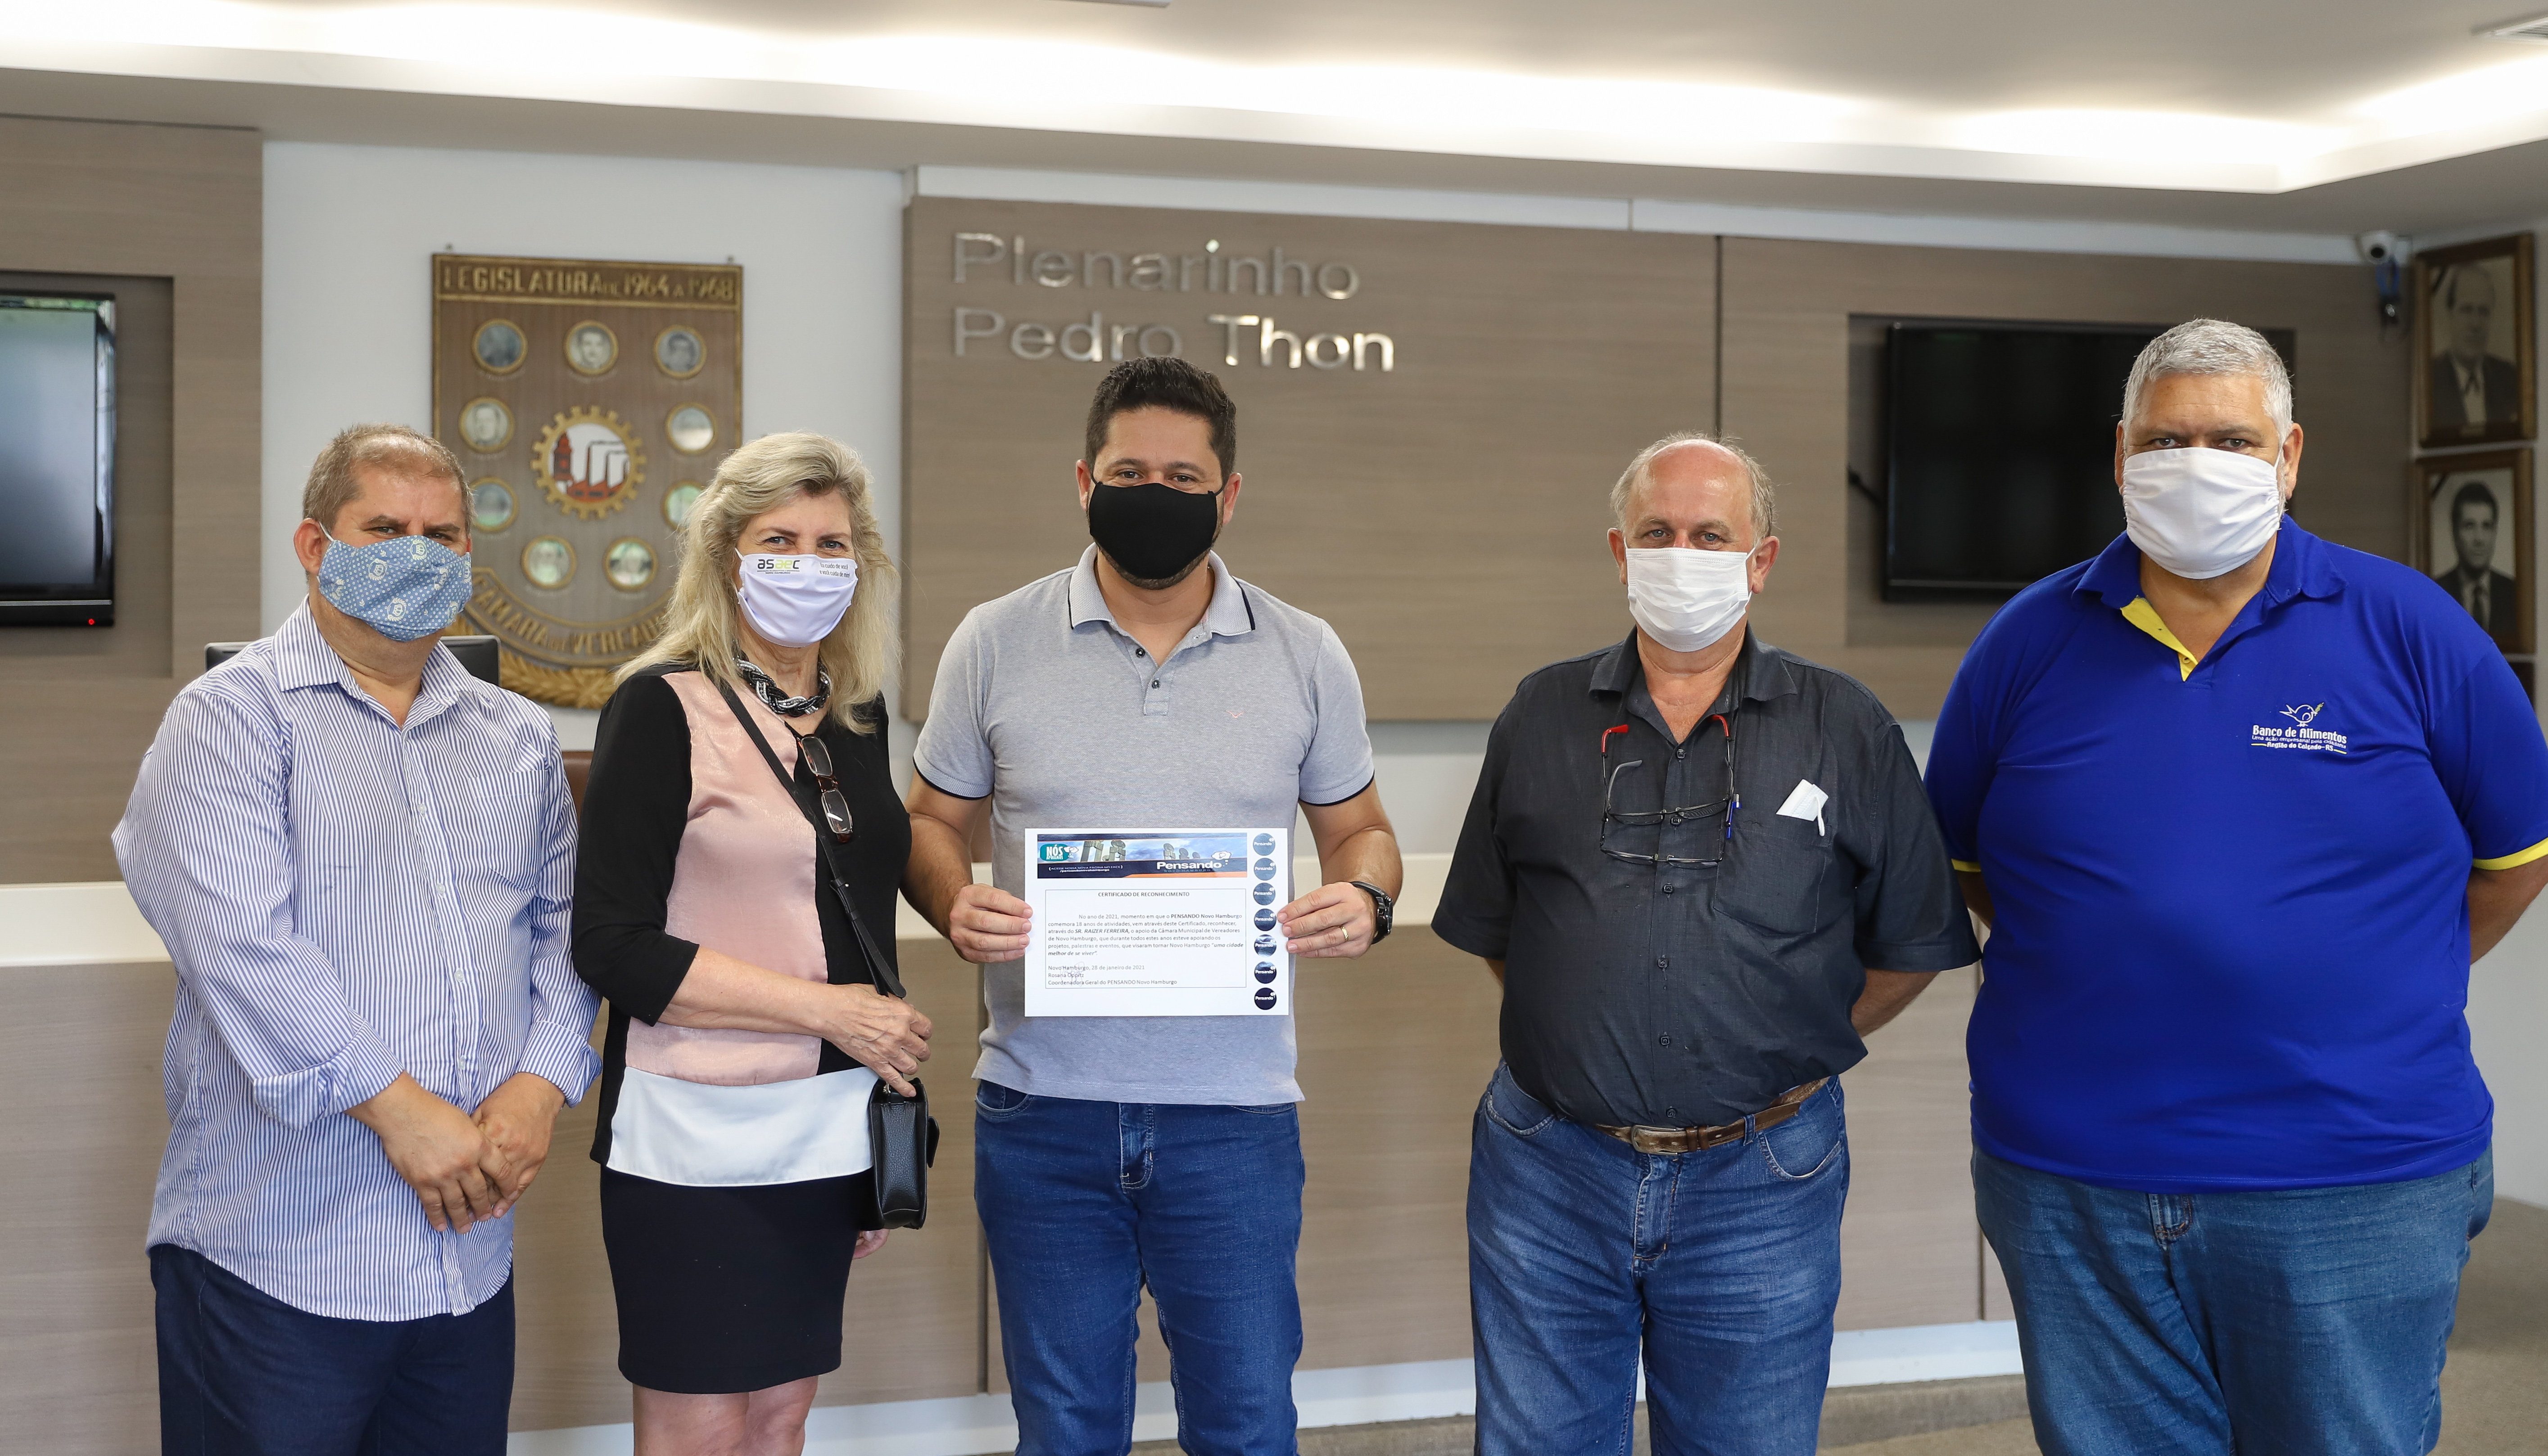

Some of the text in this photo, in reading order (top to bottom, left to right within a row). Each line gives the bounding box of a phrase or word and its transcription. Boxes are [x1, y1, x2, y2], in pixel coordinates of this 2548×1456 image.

[953, 232, 1359, 300] Plenarinho
[445, 266, 602, 295] LEGISLATURA
[623, 273, 669, 297] 1964
[688, 278, 734, 300] 1968
[953, 307, 1394, 372] Pedro Thon
[2253, 725, 2347, 743] Banco de Alimentos
[1046, 844, 1063, 856] NÓS
[1157, 861, 1222, 869] Pensando
